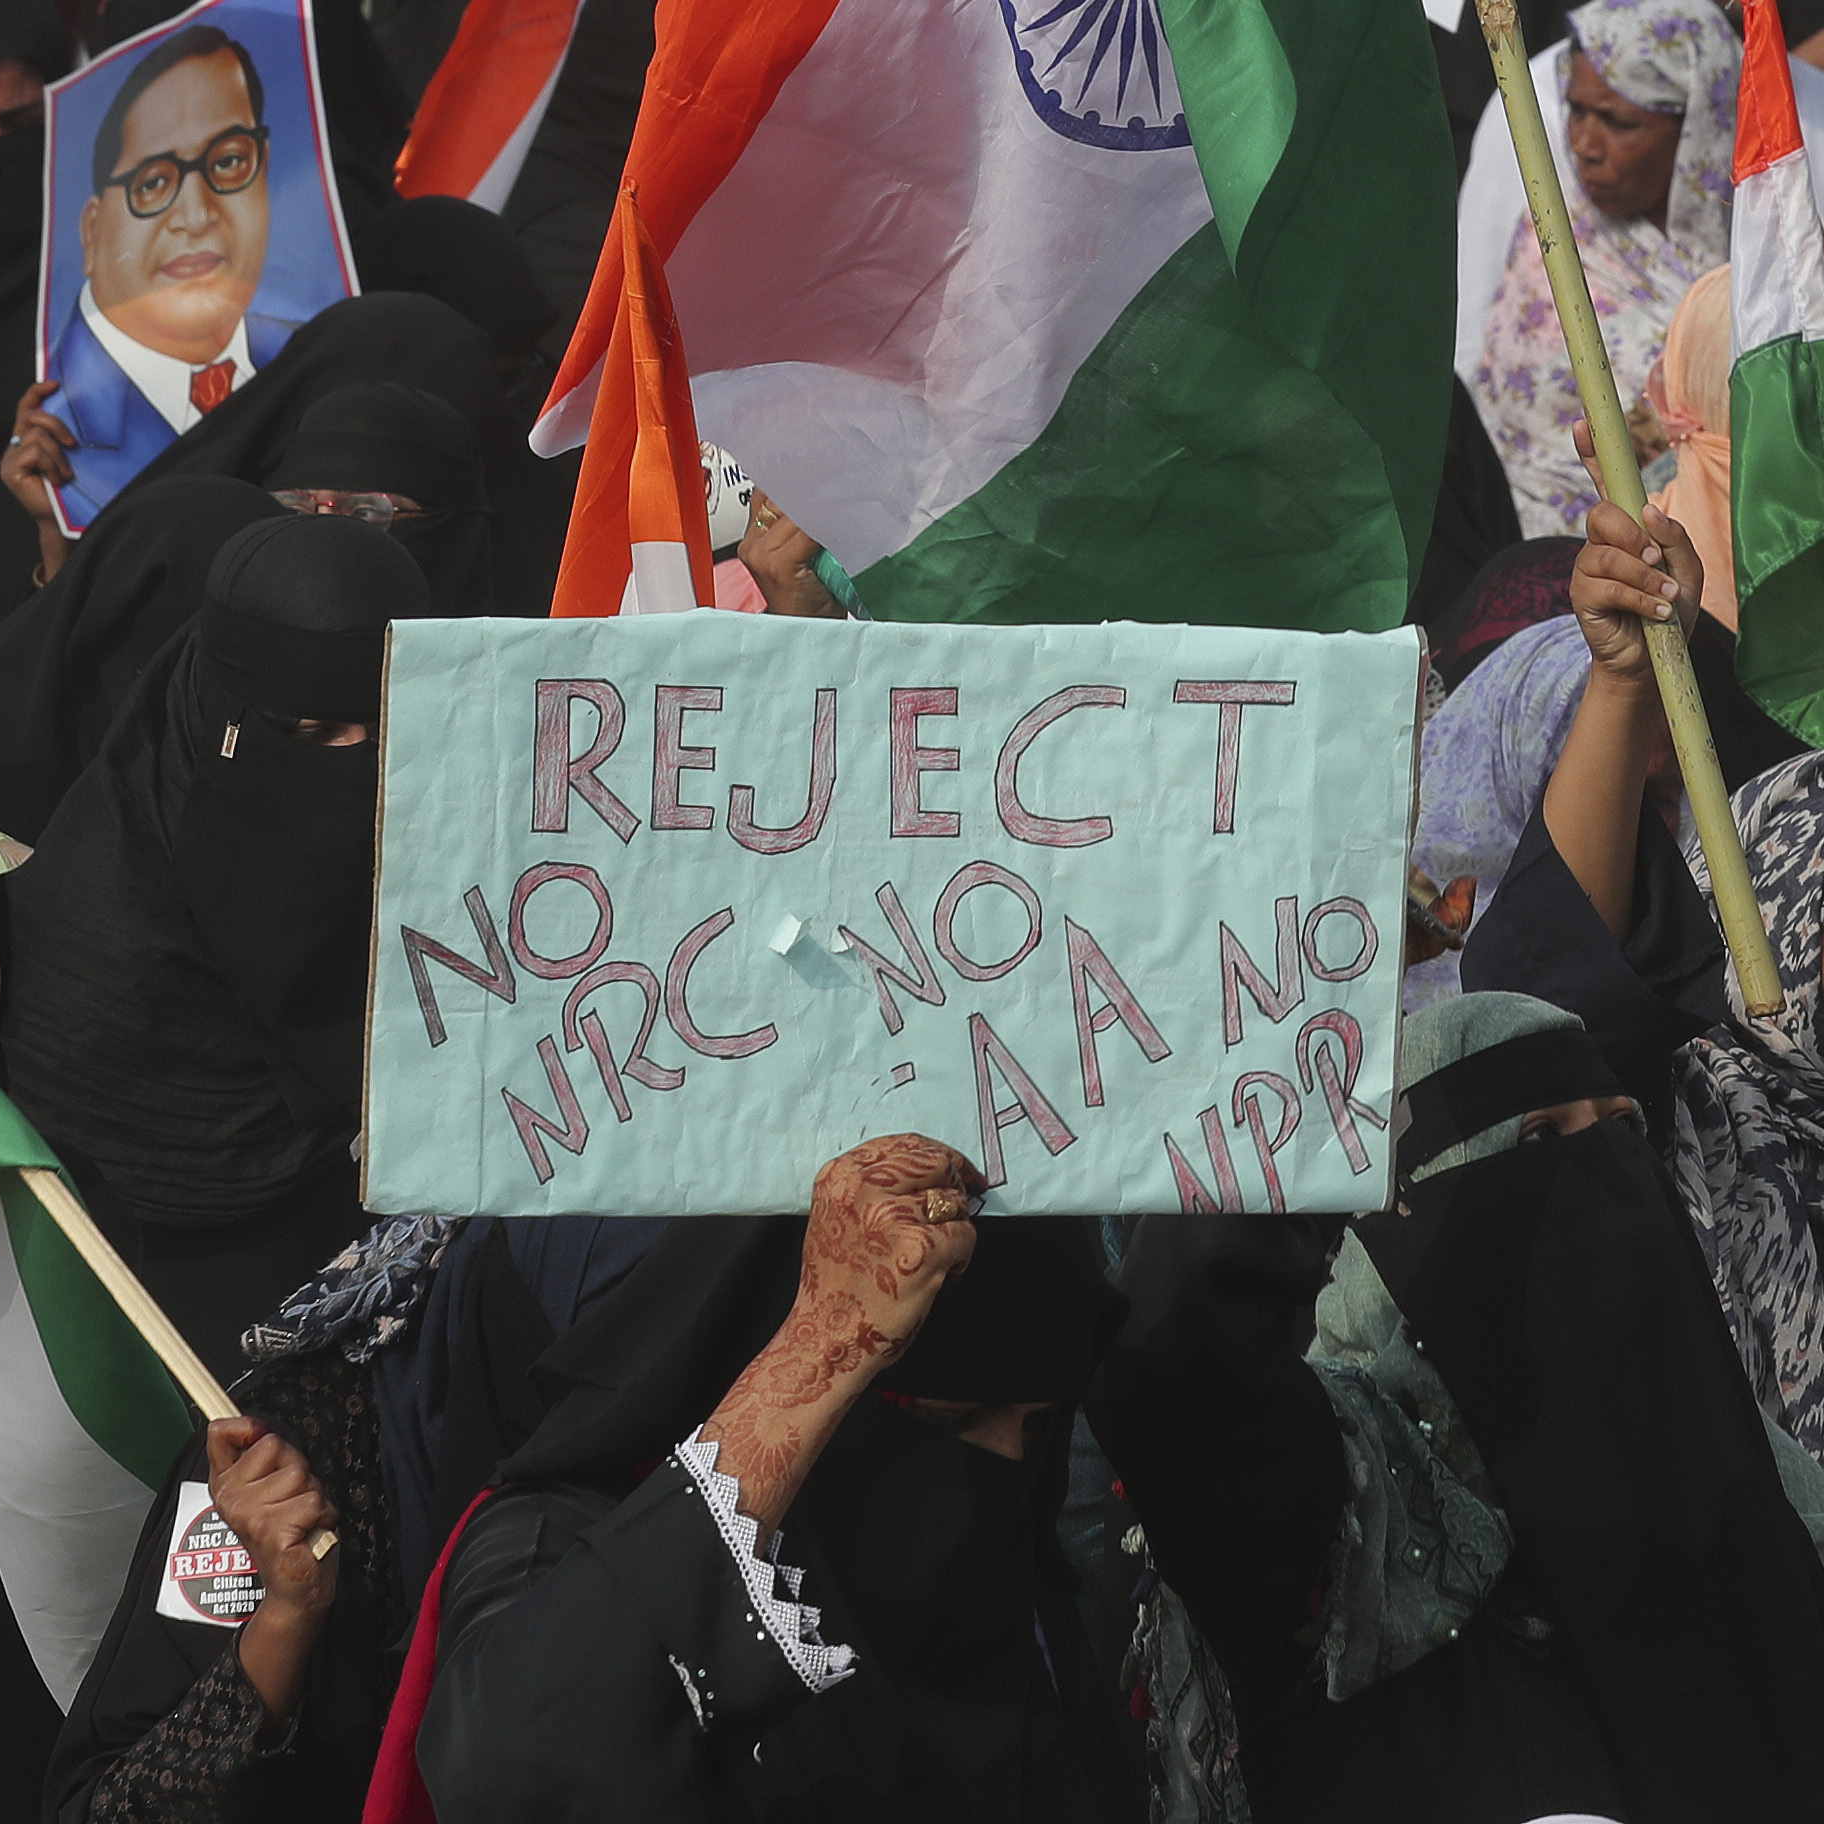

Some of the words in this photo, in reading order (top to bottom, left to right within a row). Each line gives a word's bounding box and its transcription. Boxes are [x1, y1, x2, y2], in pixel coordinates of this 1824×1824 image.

[531, 677, 1297, 855] REJECT
[401, 860, 614, 1048] NO
[838, 860, 1043, 1036] NO
[1218, 895, 1379, 1051] NO
[501, 907, 778, 1186] NRC
[889, 915, 1174, 1189] AA
[1163, 1007, 1389, 1214] NPR
[188, 1532, 221, 1550] NRC
[225, 1530, 238, 1546] &
[174, 1550, 251, 1577] REJE
[213, 1576, 252, 1590] Citizen
[213, 1603, 228, 1615] Act
[230, 1601, 254, 1614] 2020
